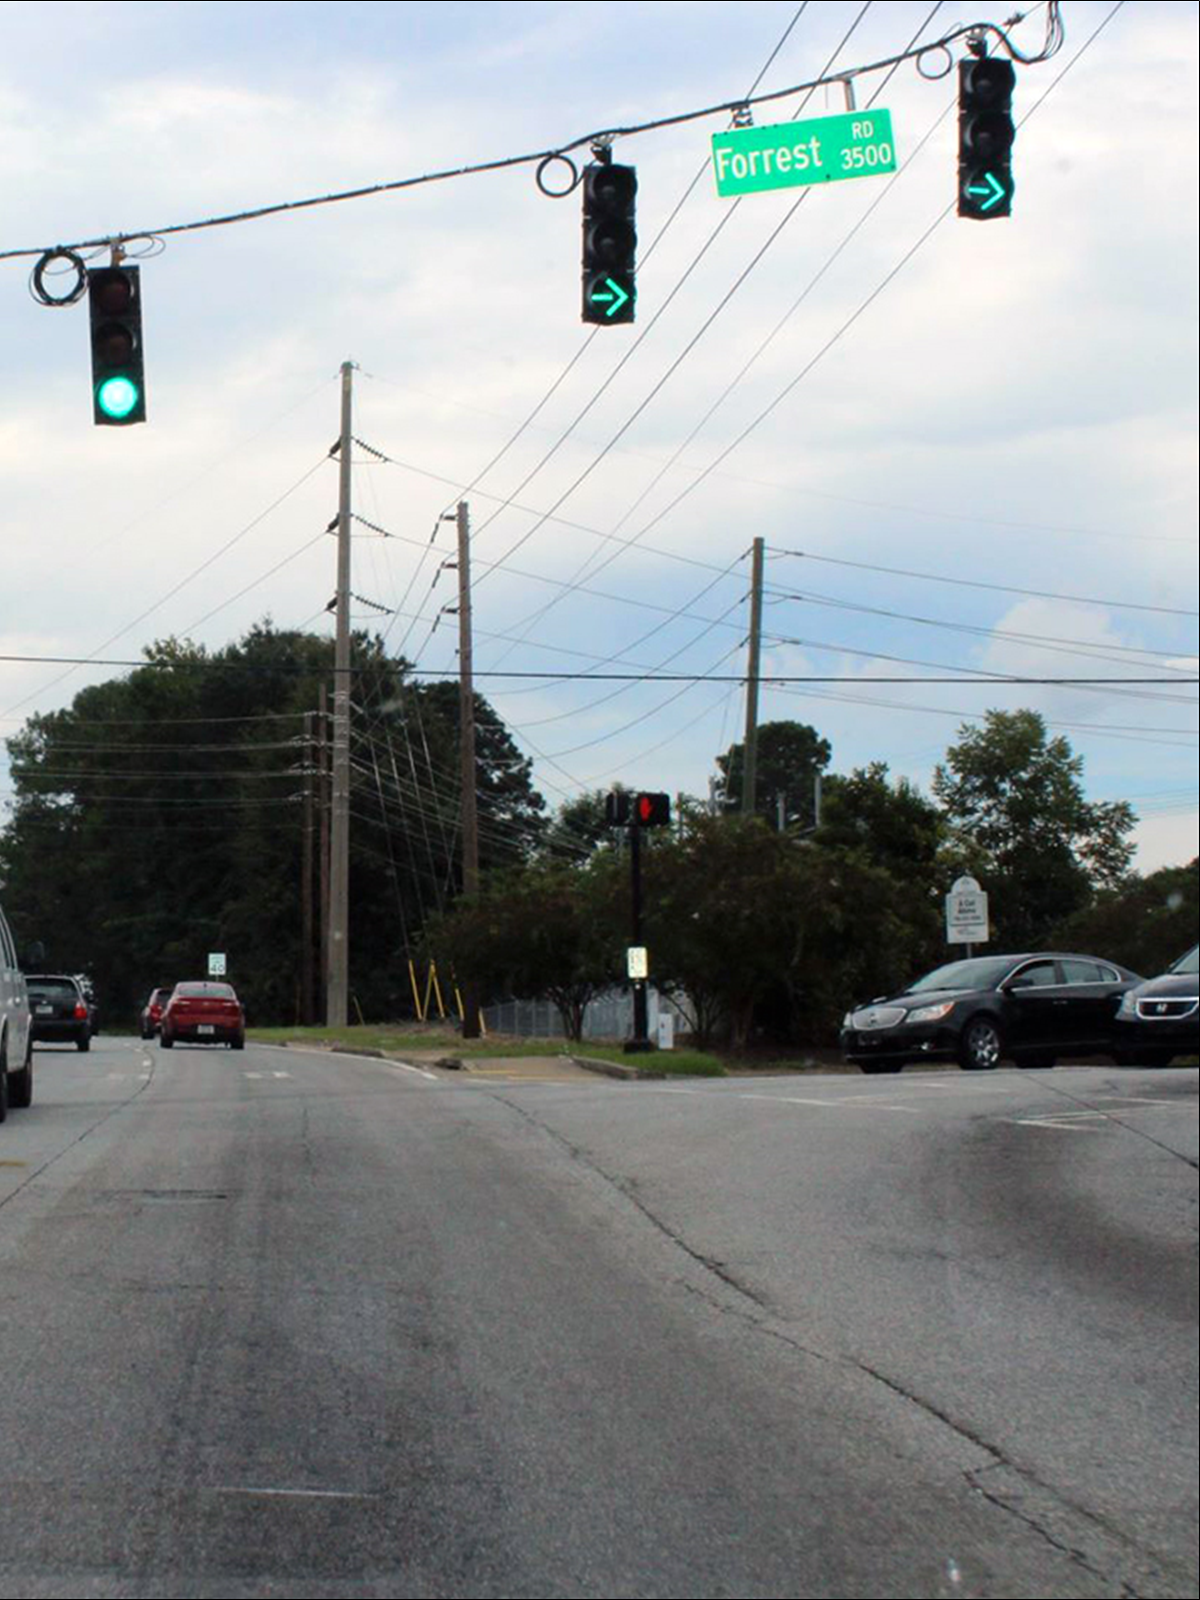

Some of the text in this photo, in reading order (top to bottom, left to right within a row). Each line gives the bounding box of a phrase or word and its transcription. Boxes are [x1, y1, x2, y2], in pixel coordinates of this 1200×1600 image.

[851, 120, 874, 140] RD
[716, 136, 823, 181] Forrest
[840, 143, 892, 170] 3500
